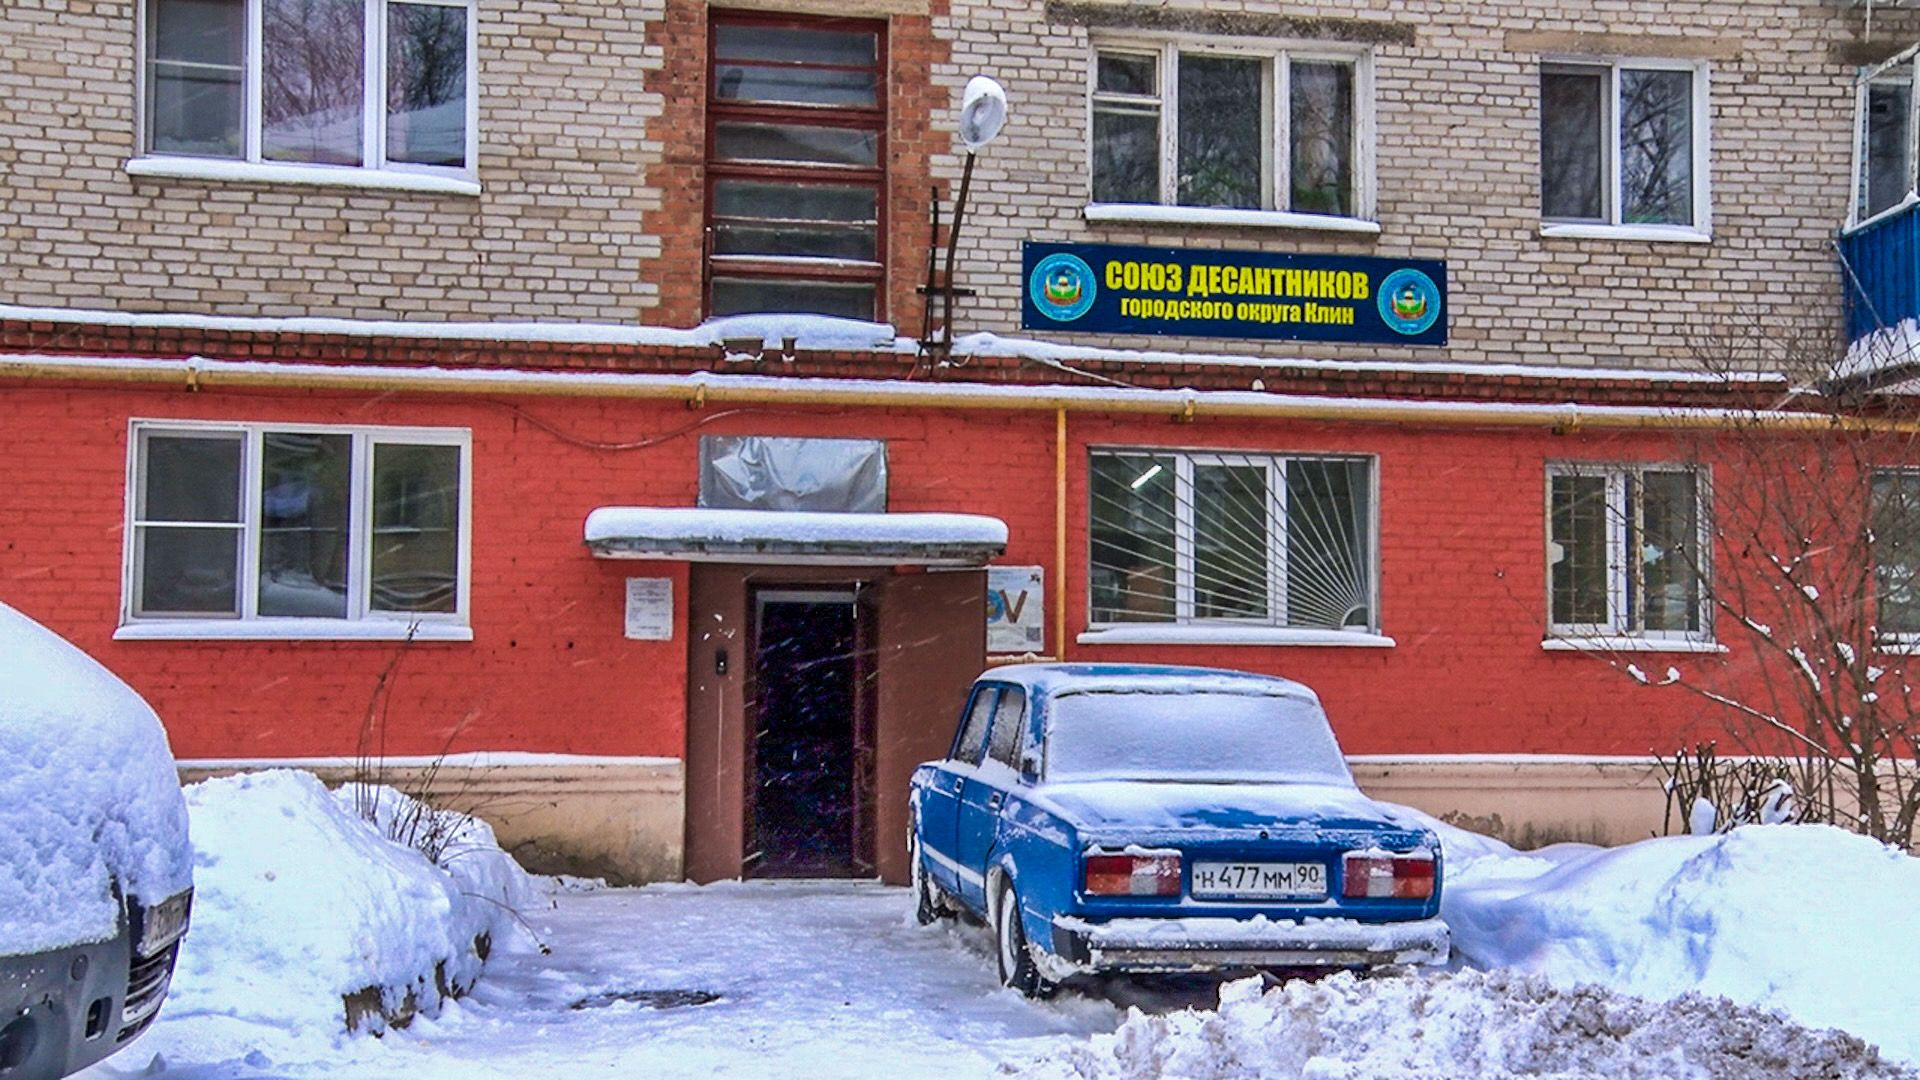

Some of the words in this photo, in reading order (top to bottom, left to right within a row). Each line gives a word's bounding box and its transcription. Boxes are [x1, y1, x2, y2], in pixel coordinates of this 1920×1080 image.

[1105, 260, 1183, 292] СОЮЗ
[1186, 264, 1369, 300] ДЕСАНТНИКОВ
[1120, 298, 1231, 320] городского
[1236, 302, 1301, 325] округа
[1304, 302, 1354, 326] Клин
[999, 589, 1028, 623] V
